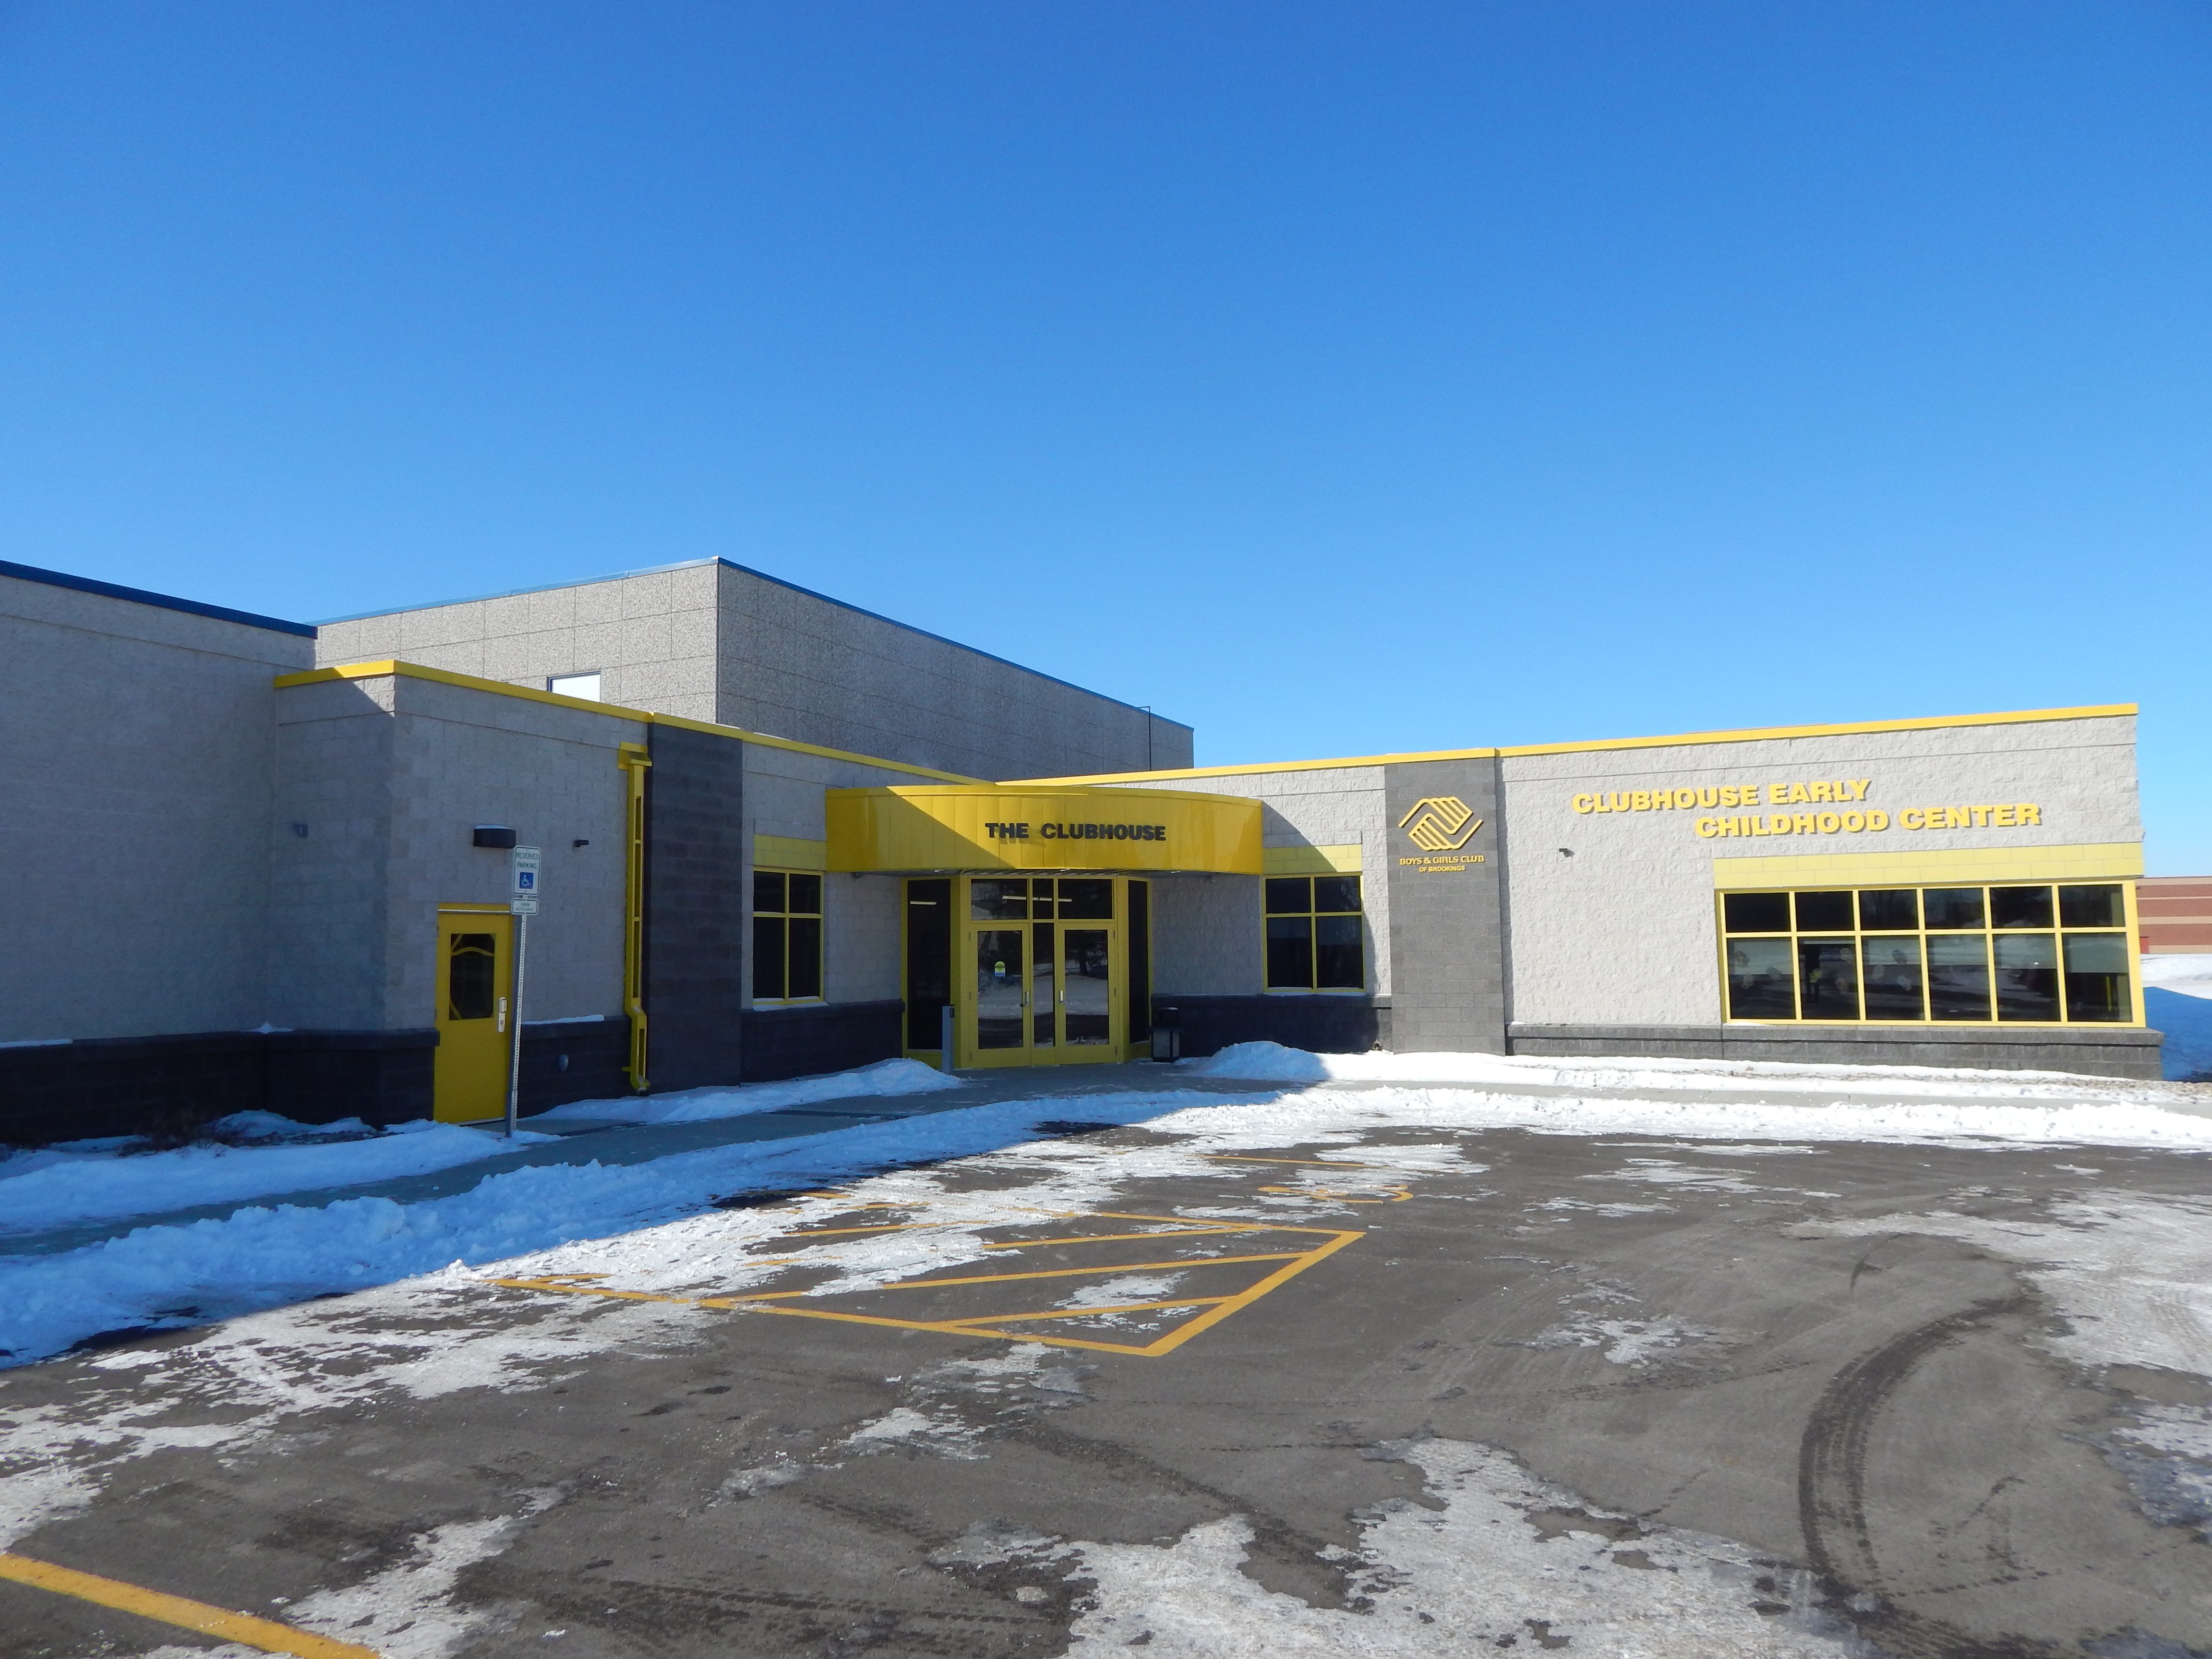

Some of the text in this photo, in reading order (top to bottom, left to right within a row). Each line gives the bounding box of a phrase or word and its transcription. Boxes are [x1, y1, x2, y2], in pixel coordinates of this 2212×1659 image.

[1572, 779, 1871, 813] CLUBHOUSE EARLY
[985, 823, 1166, 841] THE CLUBHOUSE
[1695, 803, 2041, 838] CHILDHOOD CENTER
[1399, 857, 1422, 865] BOYS
